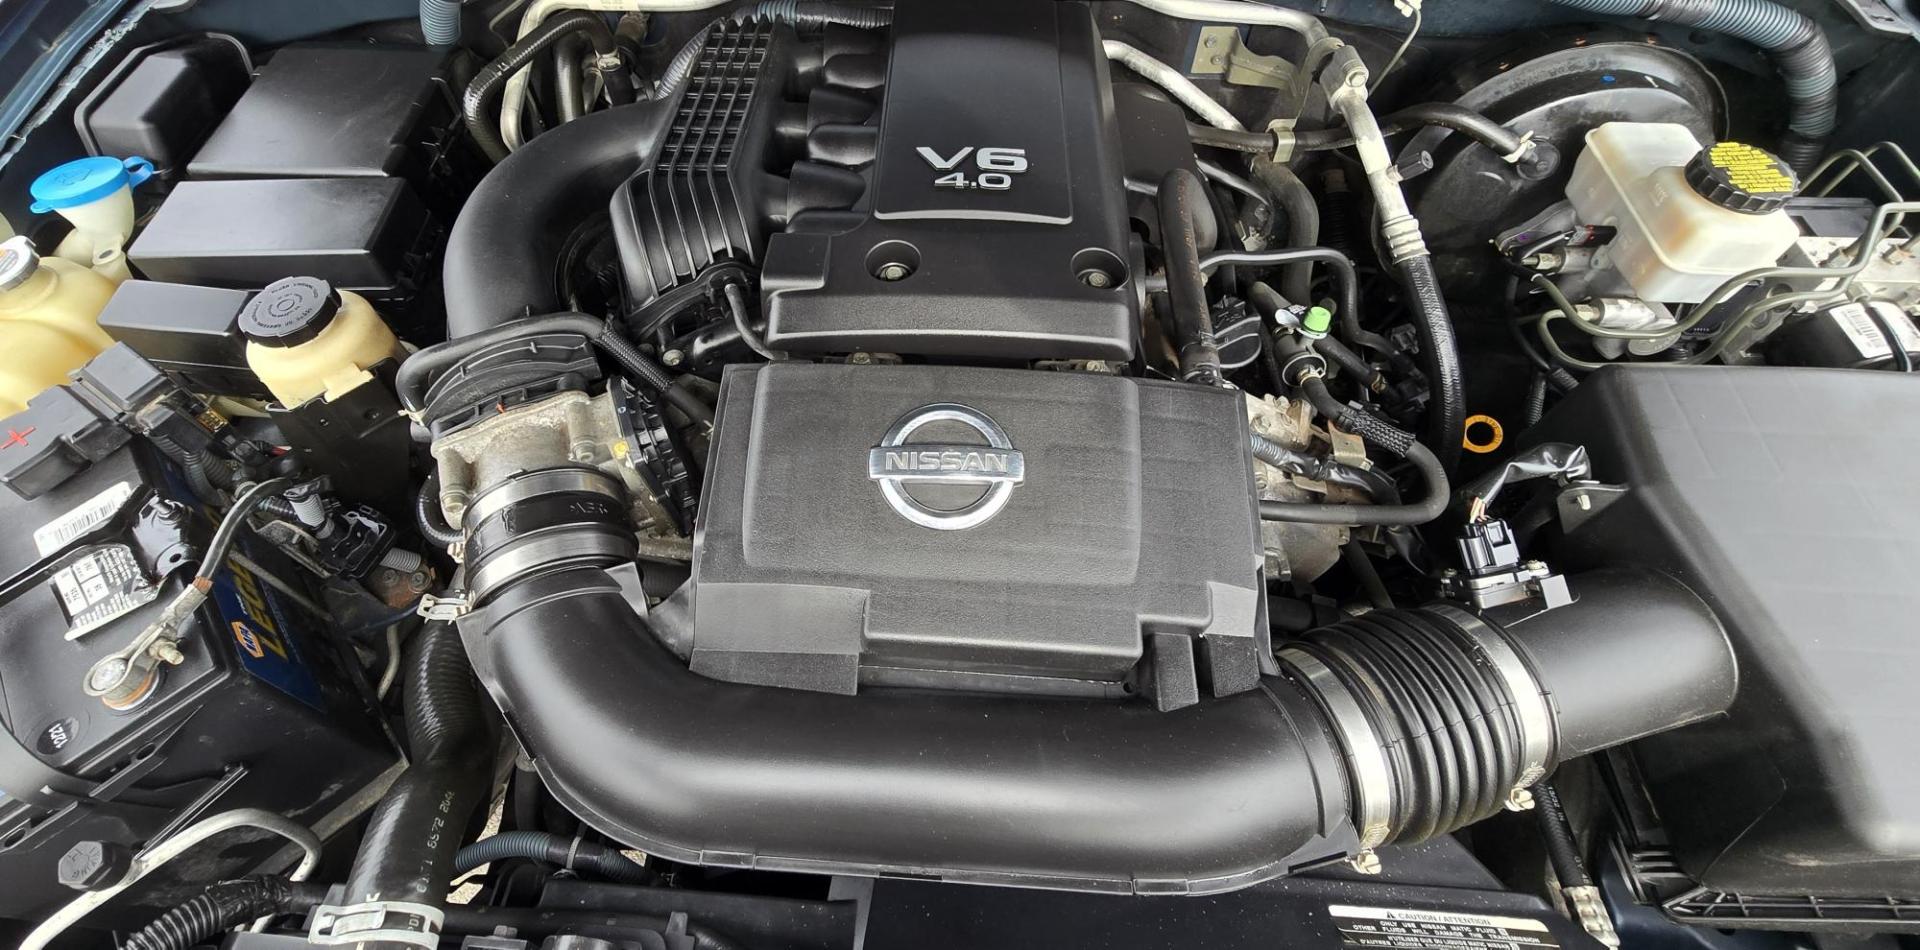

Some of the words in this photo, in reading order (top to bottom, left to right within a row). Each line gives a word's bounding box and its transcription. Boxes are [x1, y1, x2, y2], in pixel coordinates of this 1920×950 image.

[916, 146, 1028, 173] V6
[934, 172, 1012, 190] 4.0
[885, 451, 1008, 473] NISSAN
[48, 723, 68, 748] 12/21
[1398, 912, 1437, 922] CAUTION
[1443, 915, 1492, 925] ATTENTION
